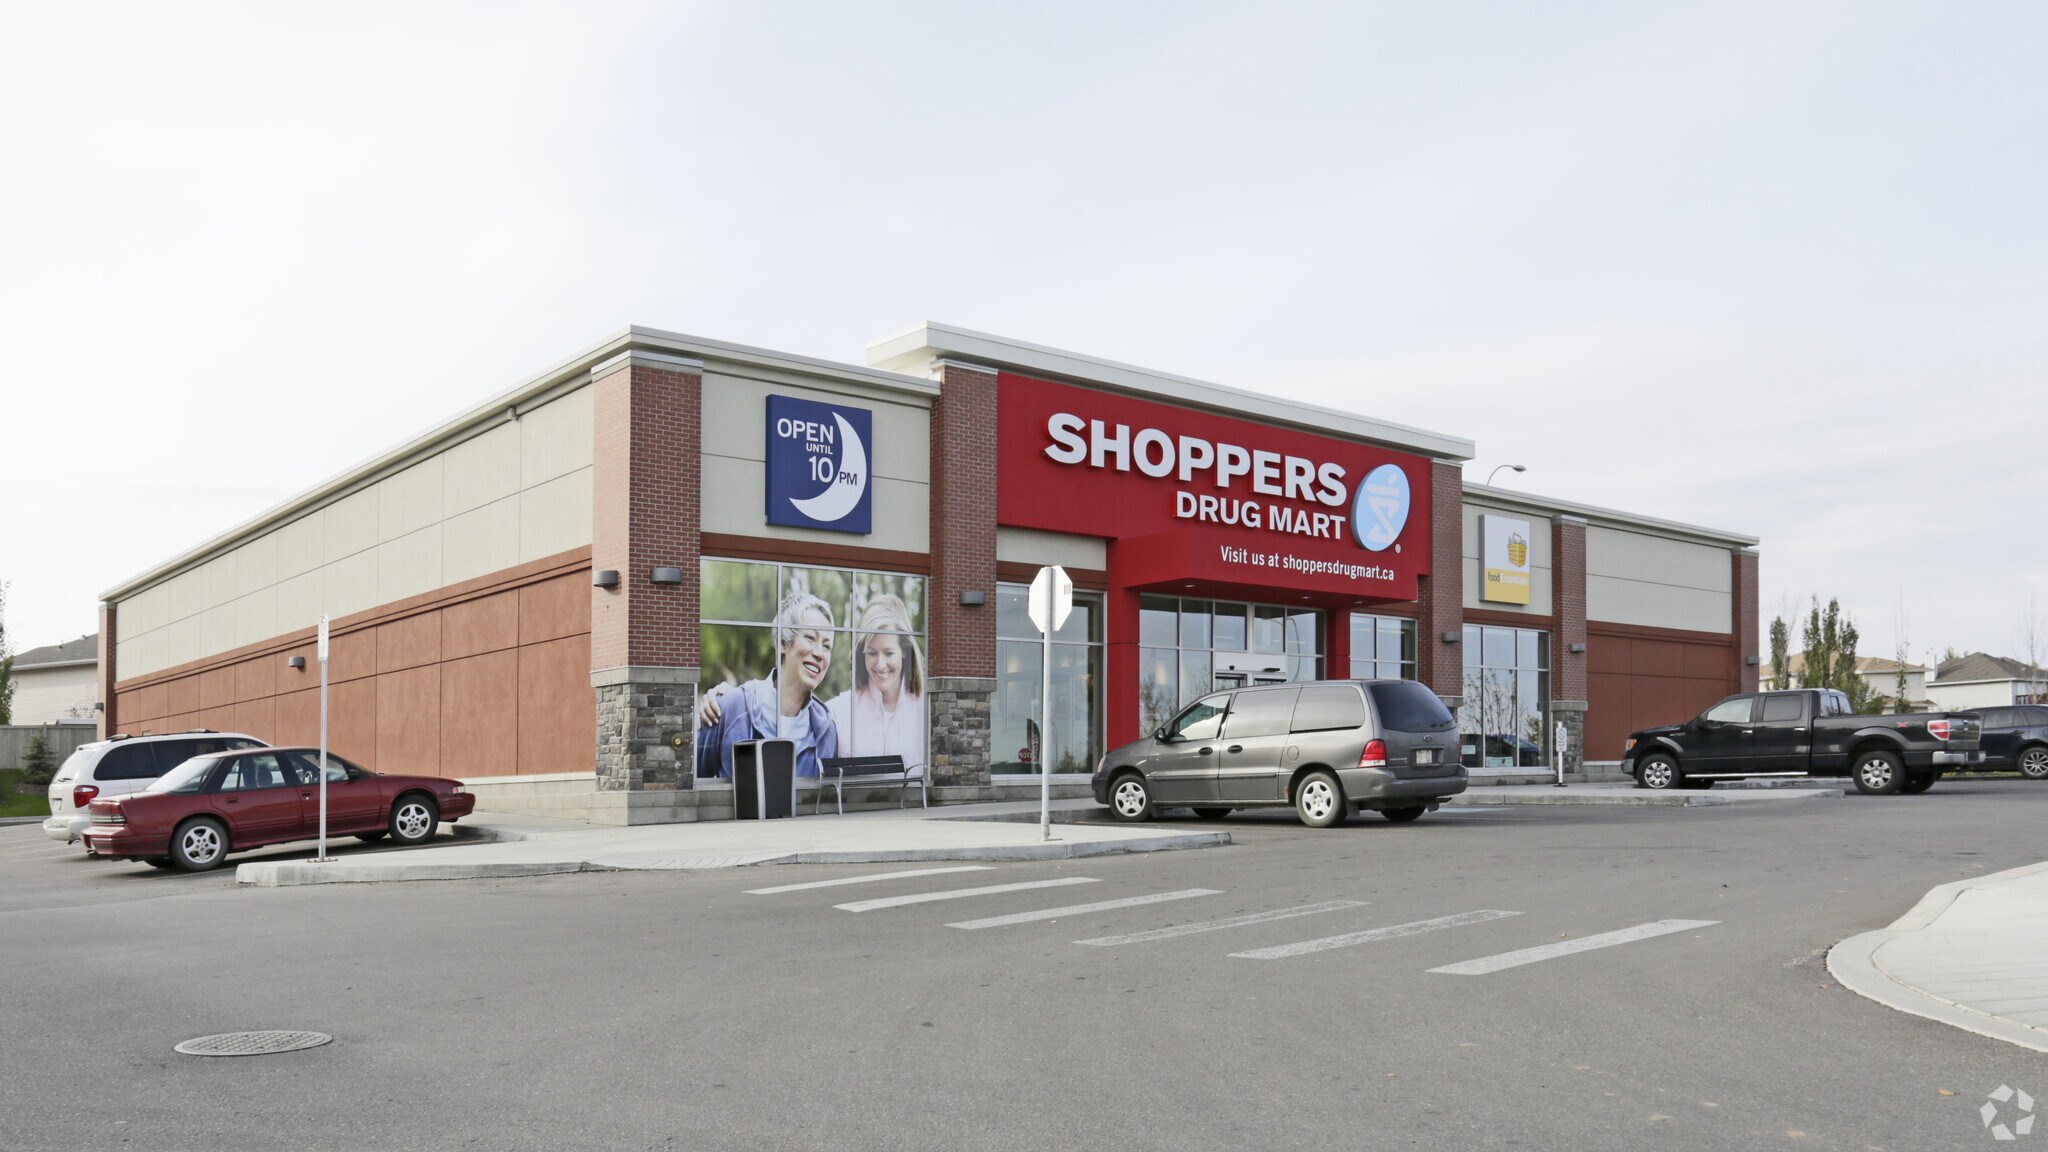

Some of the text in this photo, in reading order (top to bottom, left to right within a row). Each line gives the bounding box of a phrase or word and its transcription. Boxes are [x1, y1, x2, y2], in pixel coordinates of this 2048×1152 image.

[777, 418, 834, 444] OPEN
[806, 442, 833, 455] UNTIL
[1044, 412, 1347, 507] SHOPPERS
[808, 455, 858, 486] 10 PM
[1176, 490, 1346, 540] DRUG MART
[1220, 545, 1395, 581] Visit us at shoppersdrugmart.ca
